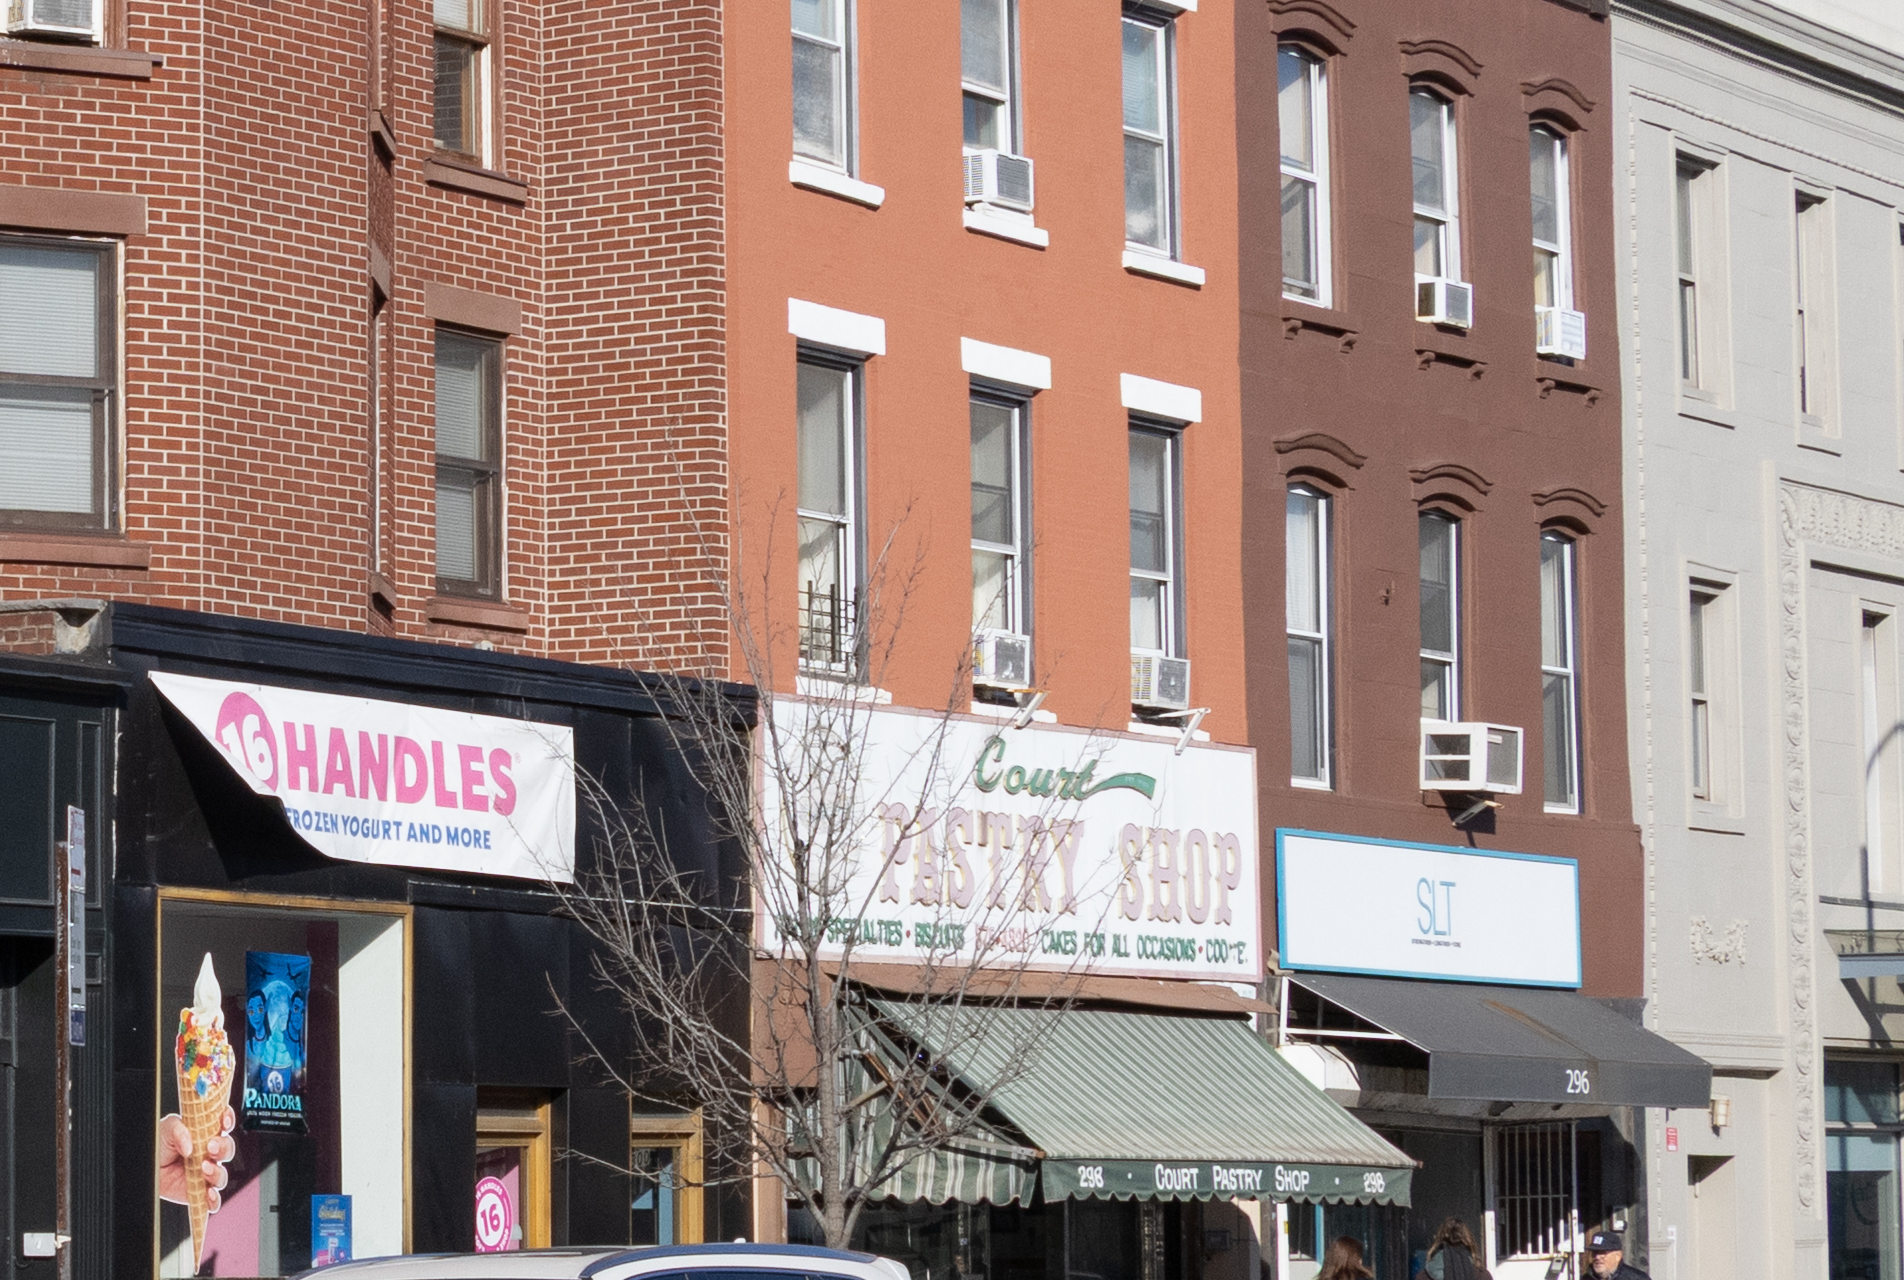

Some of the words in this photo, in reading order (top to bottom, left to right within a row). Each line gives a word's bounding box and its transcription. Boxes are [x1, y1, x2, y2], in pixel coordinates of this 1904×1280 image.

[221, 712, 274, 782] 16
[283, 720, 517, 817] HANDLES
[973, 734, 1099, 802] Court
[284, 807, 339, 835] FROZEN
[341, 814, 403, 841] YOGURT
[407, 823, 442, 844] AND
[446, 827, 492, 851] MORE
[878, 802, 1085, 916] PASTRY
[1117, 822, 1242, 927] SHOP
[1416, 877, 1456, 936] SLT
[1042, 929, 1077, 957] CAKES
[1084, 931, 1106, 958] FOR
[1112, 932, 1130, 958] ALL
[1137, 934, 1196, 963] OCCASIONS
[245, 1086, 303, 1111] PANDORA
[1566, 1069, 1590, 1095] 296
[1077, 1166, 1105, 1189] 298
[1363, 1171, 1386, 1194] 298
[480, 1203, 501, 1238] 16
